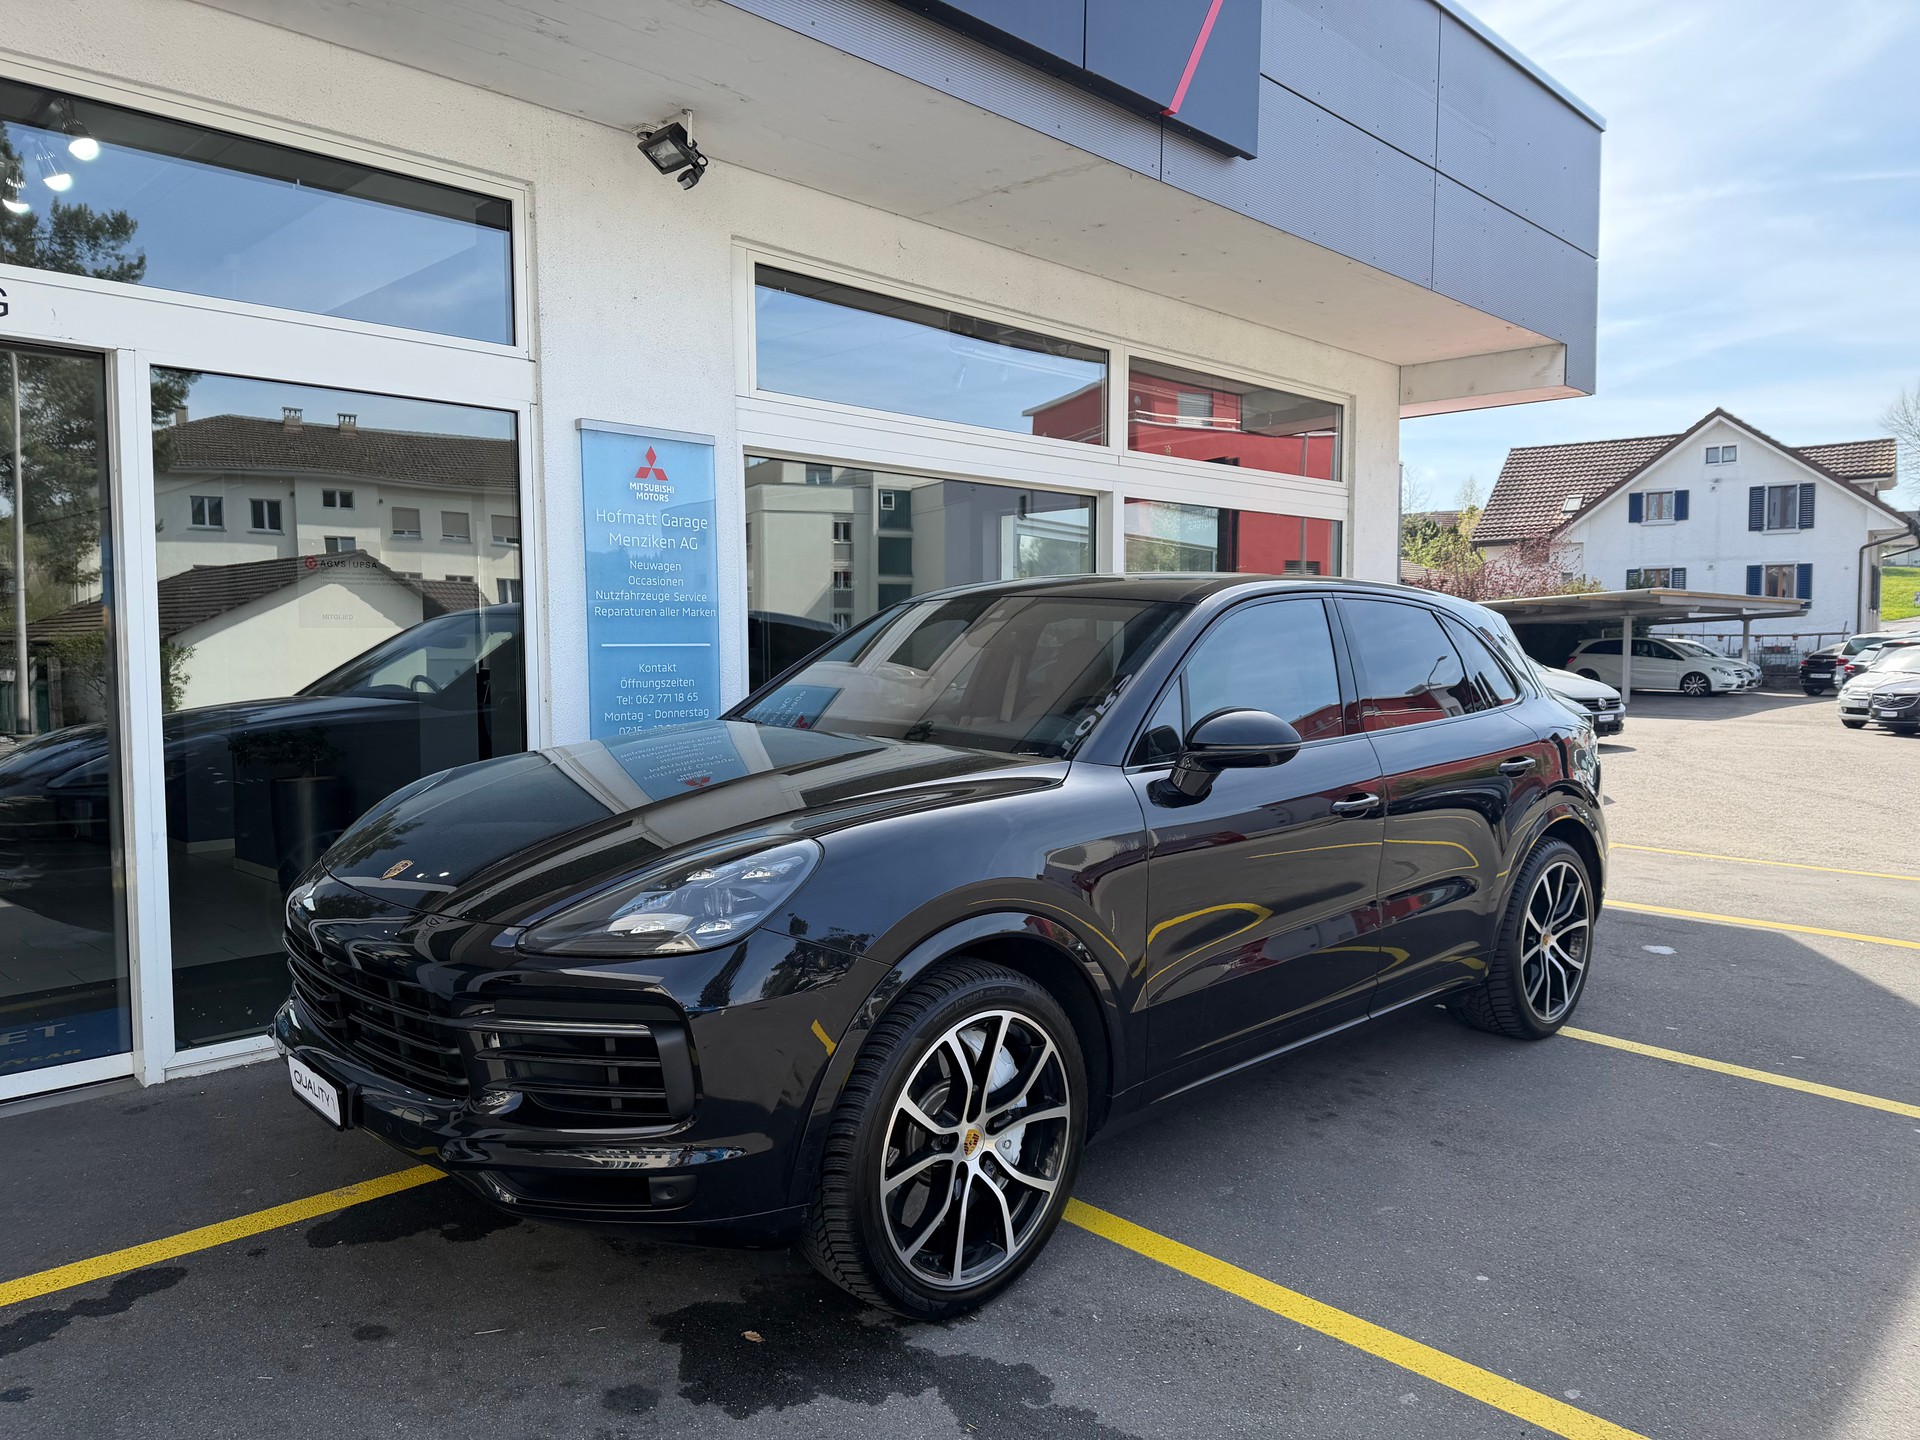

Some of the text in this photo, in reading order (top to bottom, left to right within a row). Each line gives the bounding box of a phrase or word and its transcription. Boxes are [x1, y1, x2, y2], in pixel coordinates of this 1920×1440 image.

[629, 482, 675, 494] MITSUBISHI
[636, 493, 669, 502] MOTORS
[596, 509, 708, 531] Hofmatt Garage
[609, 532, 698, 549] Menziken AG
[320, 560, 378, 569] AGVS UPSA
[629, 560, 682, 573] Neuwagen
[628, 576, 684, 587] Occasionen
[595, 590, 707, 603] Nutzfahrzeuge Service
[594, 606, 716, 618] Reparaturen aller Marken
[638, 663, 677, 673] Kontakt
[620, 677, 695, 690] Öffnungszeiten
[635, 694, 654, 704] 062
[657, 693, 672, 703] 771
[674, 692, 684, 702] 18
[687, 692, 699, 702] 65
[604, 711, 644, 723] Montag
[655, 708, 710, 720] Donnerstag
